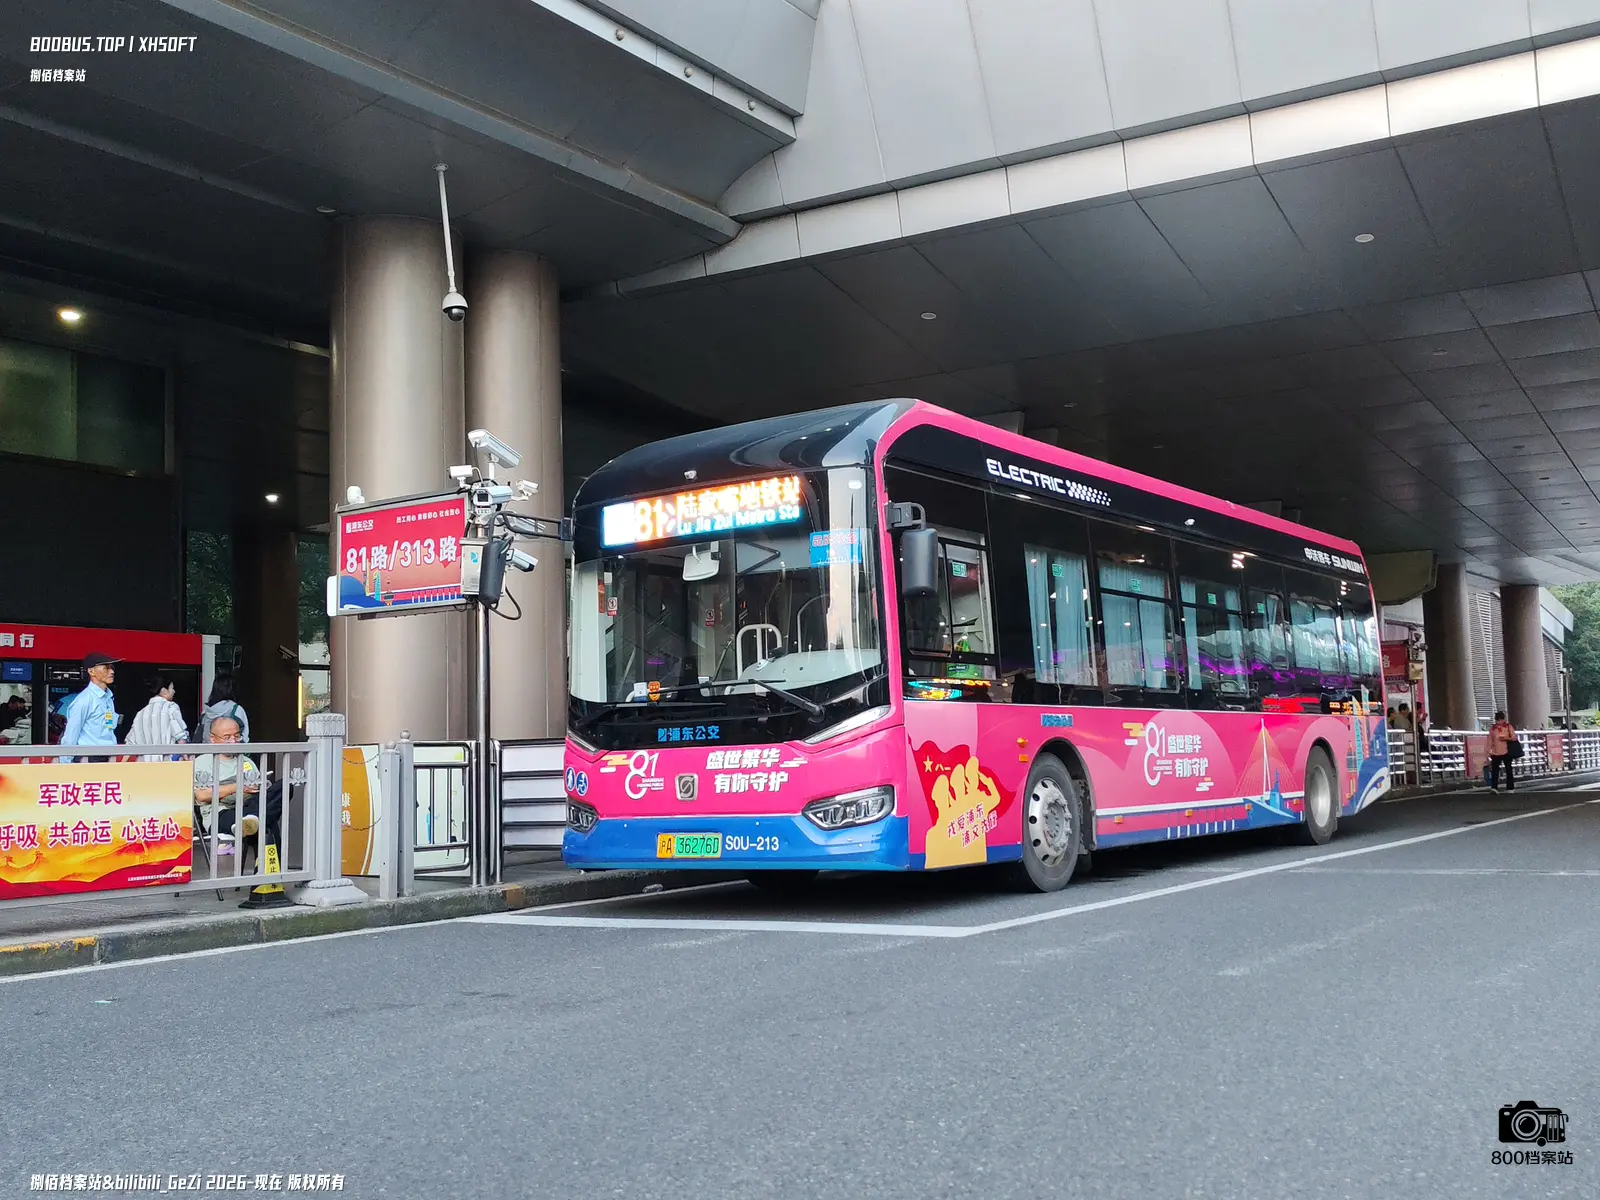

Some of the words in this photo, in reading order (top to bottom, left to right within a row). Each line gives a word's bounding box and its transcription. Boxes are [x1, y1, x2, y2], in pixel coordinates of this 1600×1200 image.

[986, 458, 1066, 494] ELECTRIC
[713, 515, 733, 530] Zui
[736, 510, 774, 526] Metro
[346, 536, 457, 573] 81路/313路
[1331, 555, 1364, 574] SUNWIN
[669, 725, 720, 741] 浦东公交
[1168, 735, 1201, 753] 盛世繁华
[706, 748, 780, 770] 盛世繁华
[935, 763, 951, 771] 八一
[1175, 757, 1208, 777] 有你守护
[714, 771, 789, 793] 有你守护
[39, 782, 122, 807] 军政军民
[948, 803, 983, 838] 我爱浦东
[0, 824, 38, 850] 呼吸
[49, 820, 112, 847] 共命运
[121, 817, 179, 842] 心连心
